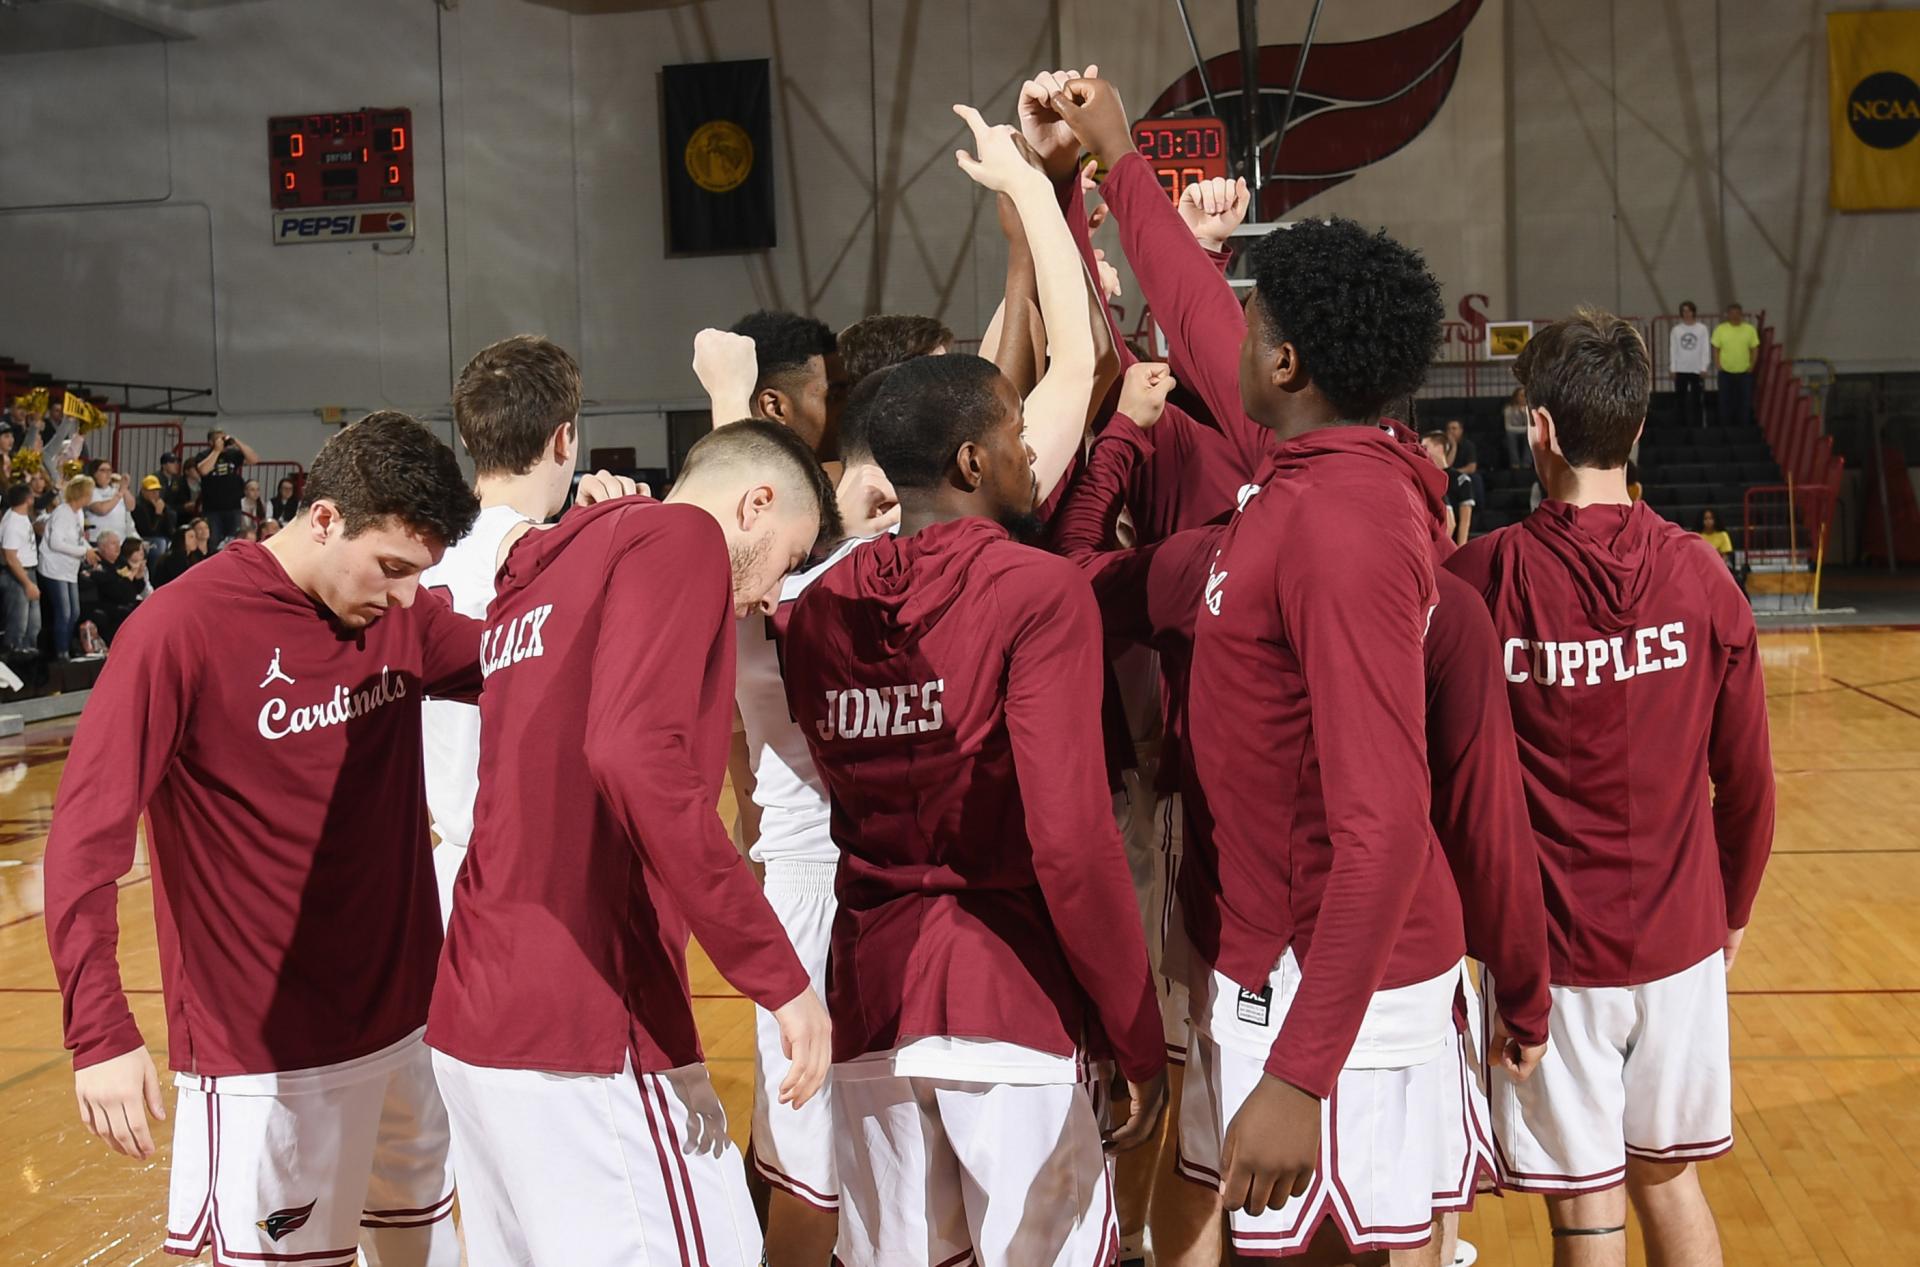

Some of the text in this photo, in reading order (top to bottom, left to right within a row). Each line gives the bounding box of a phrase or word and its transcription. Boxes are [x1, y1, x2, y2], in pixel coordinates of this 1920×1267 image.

[1852, 100, 1920, 121] NCAA
[290, 133, 304, 158] 0
[391, 127, 405, 151] 0
[1139, 129, 1220, 160] 20:00
[362, 147, 368, 163] 1
[285, 171, 296, 190] 0
[388, 165, 400, 184] 0
[280, 215, 356, 238] PEPSI
[480, 603, 553, 679] LLACK
[1504, 621, 1687, 687] CUPPLES
[258, 665, 406, 740] Cardinals
[816, 678, 944, 741] JONES
